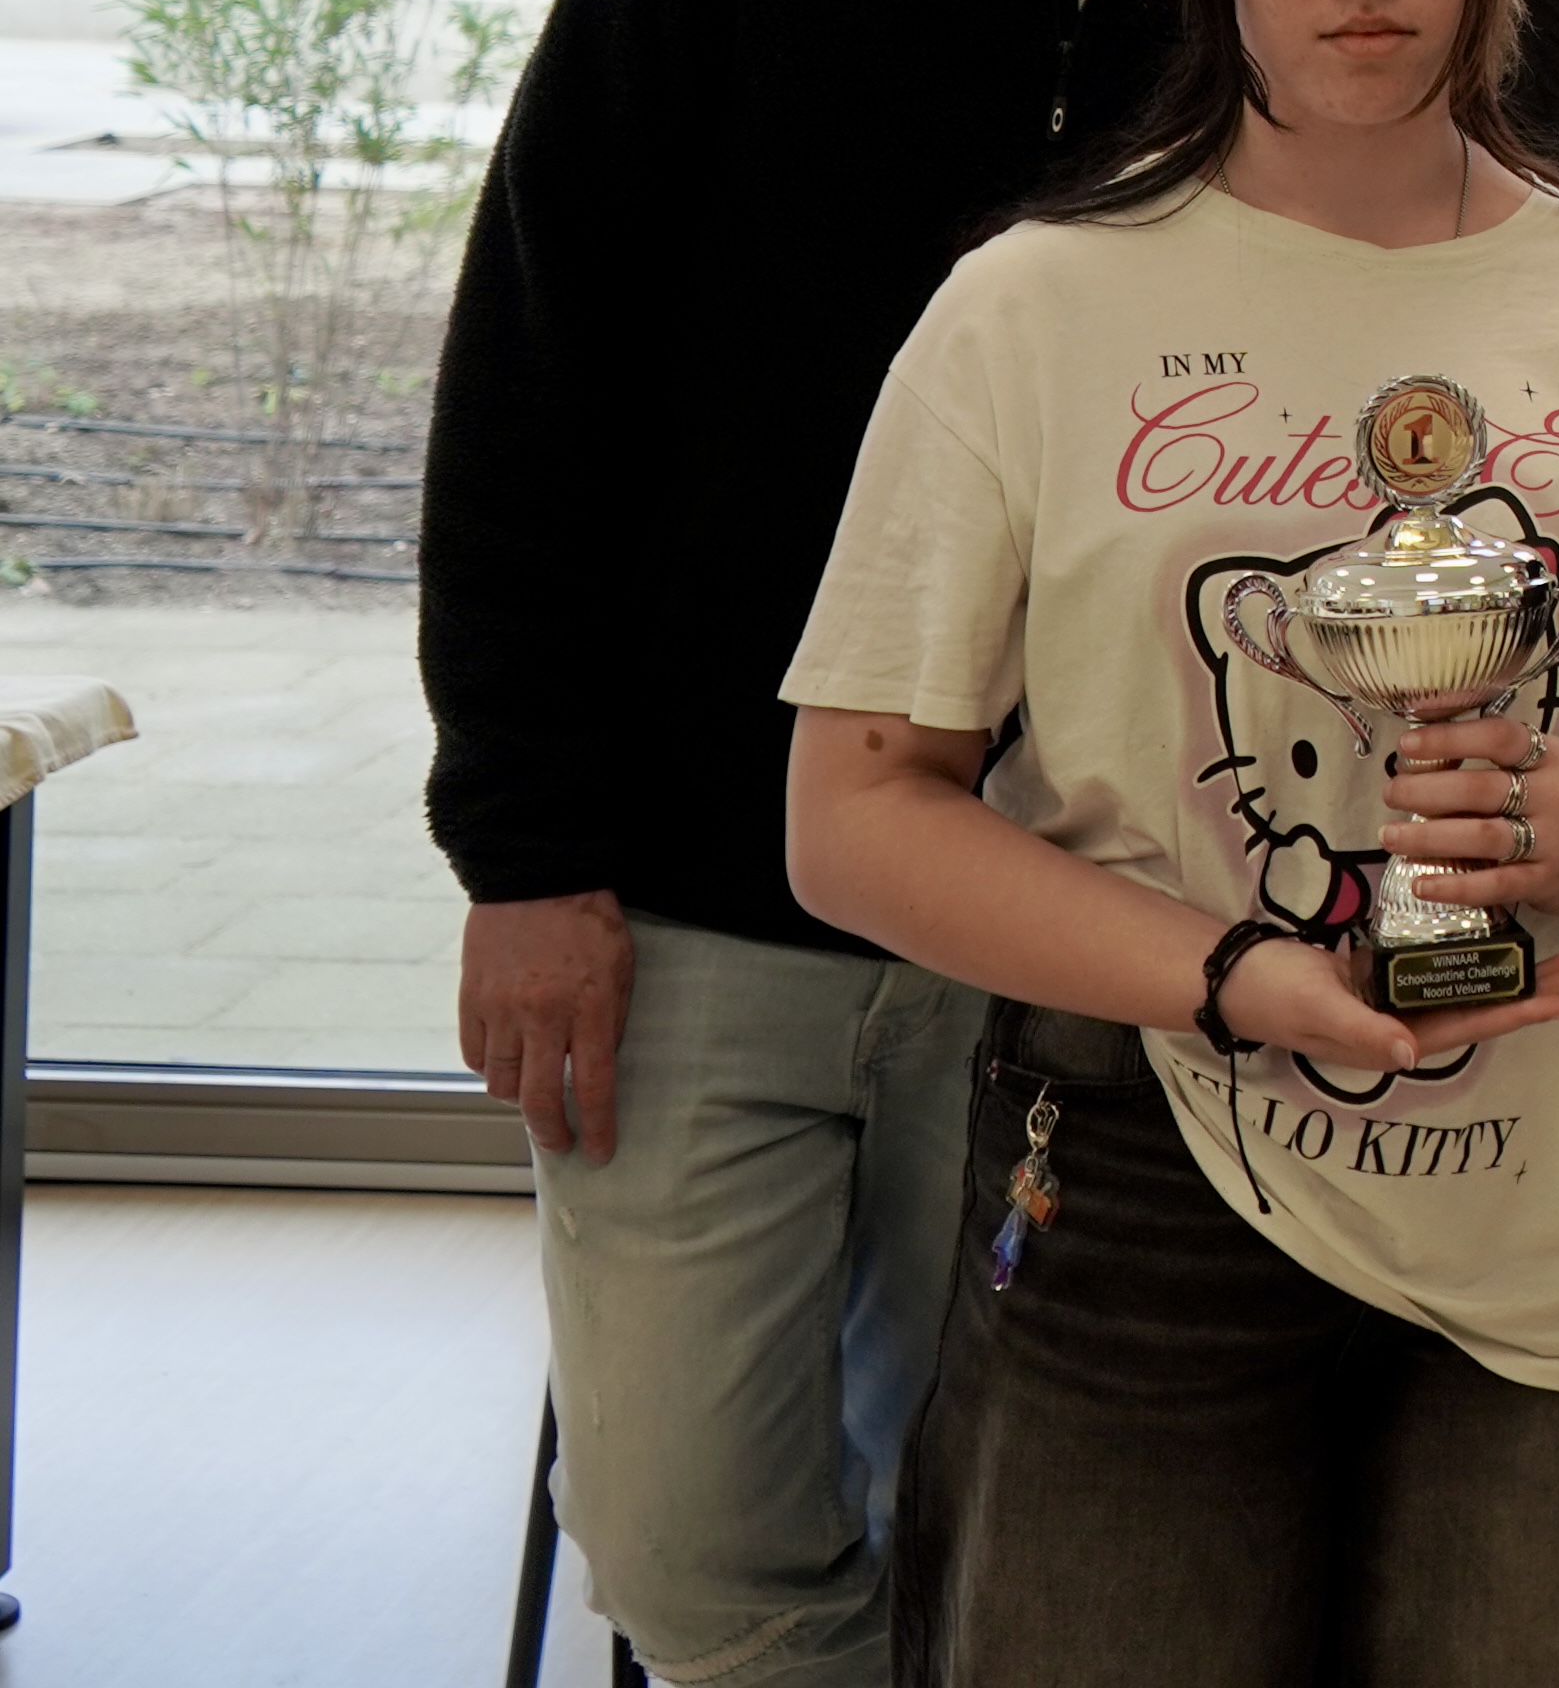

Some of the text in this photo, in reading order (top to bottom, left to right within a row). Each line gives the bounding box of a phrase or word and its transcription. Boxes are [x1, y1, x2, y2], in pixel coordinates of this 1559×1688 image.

[1159, 351, 1249, 378] IN MY
[1402, 414, 1439, 465] 1
[1432, 952, 1480, 968] WINNAAR
[1396, 964, 1516, 987] Schoolkantine Challenge
[1423, 982, 1491, 999] Noord Veluwe
[1346, 1116, 1522, 1177] KITTY
